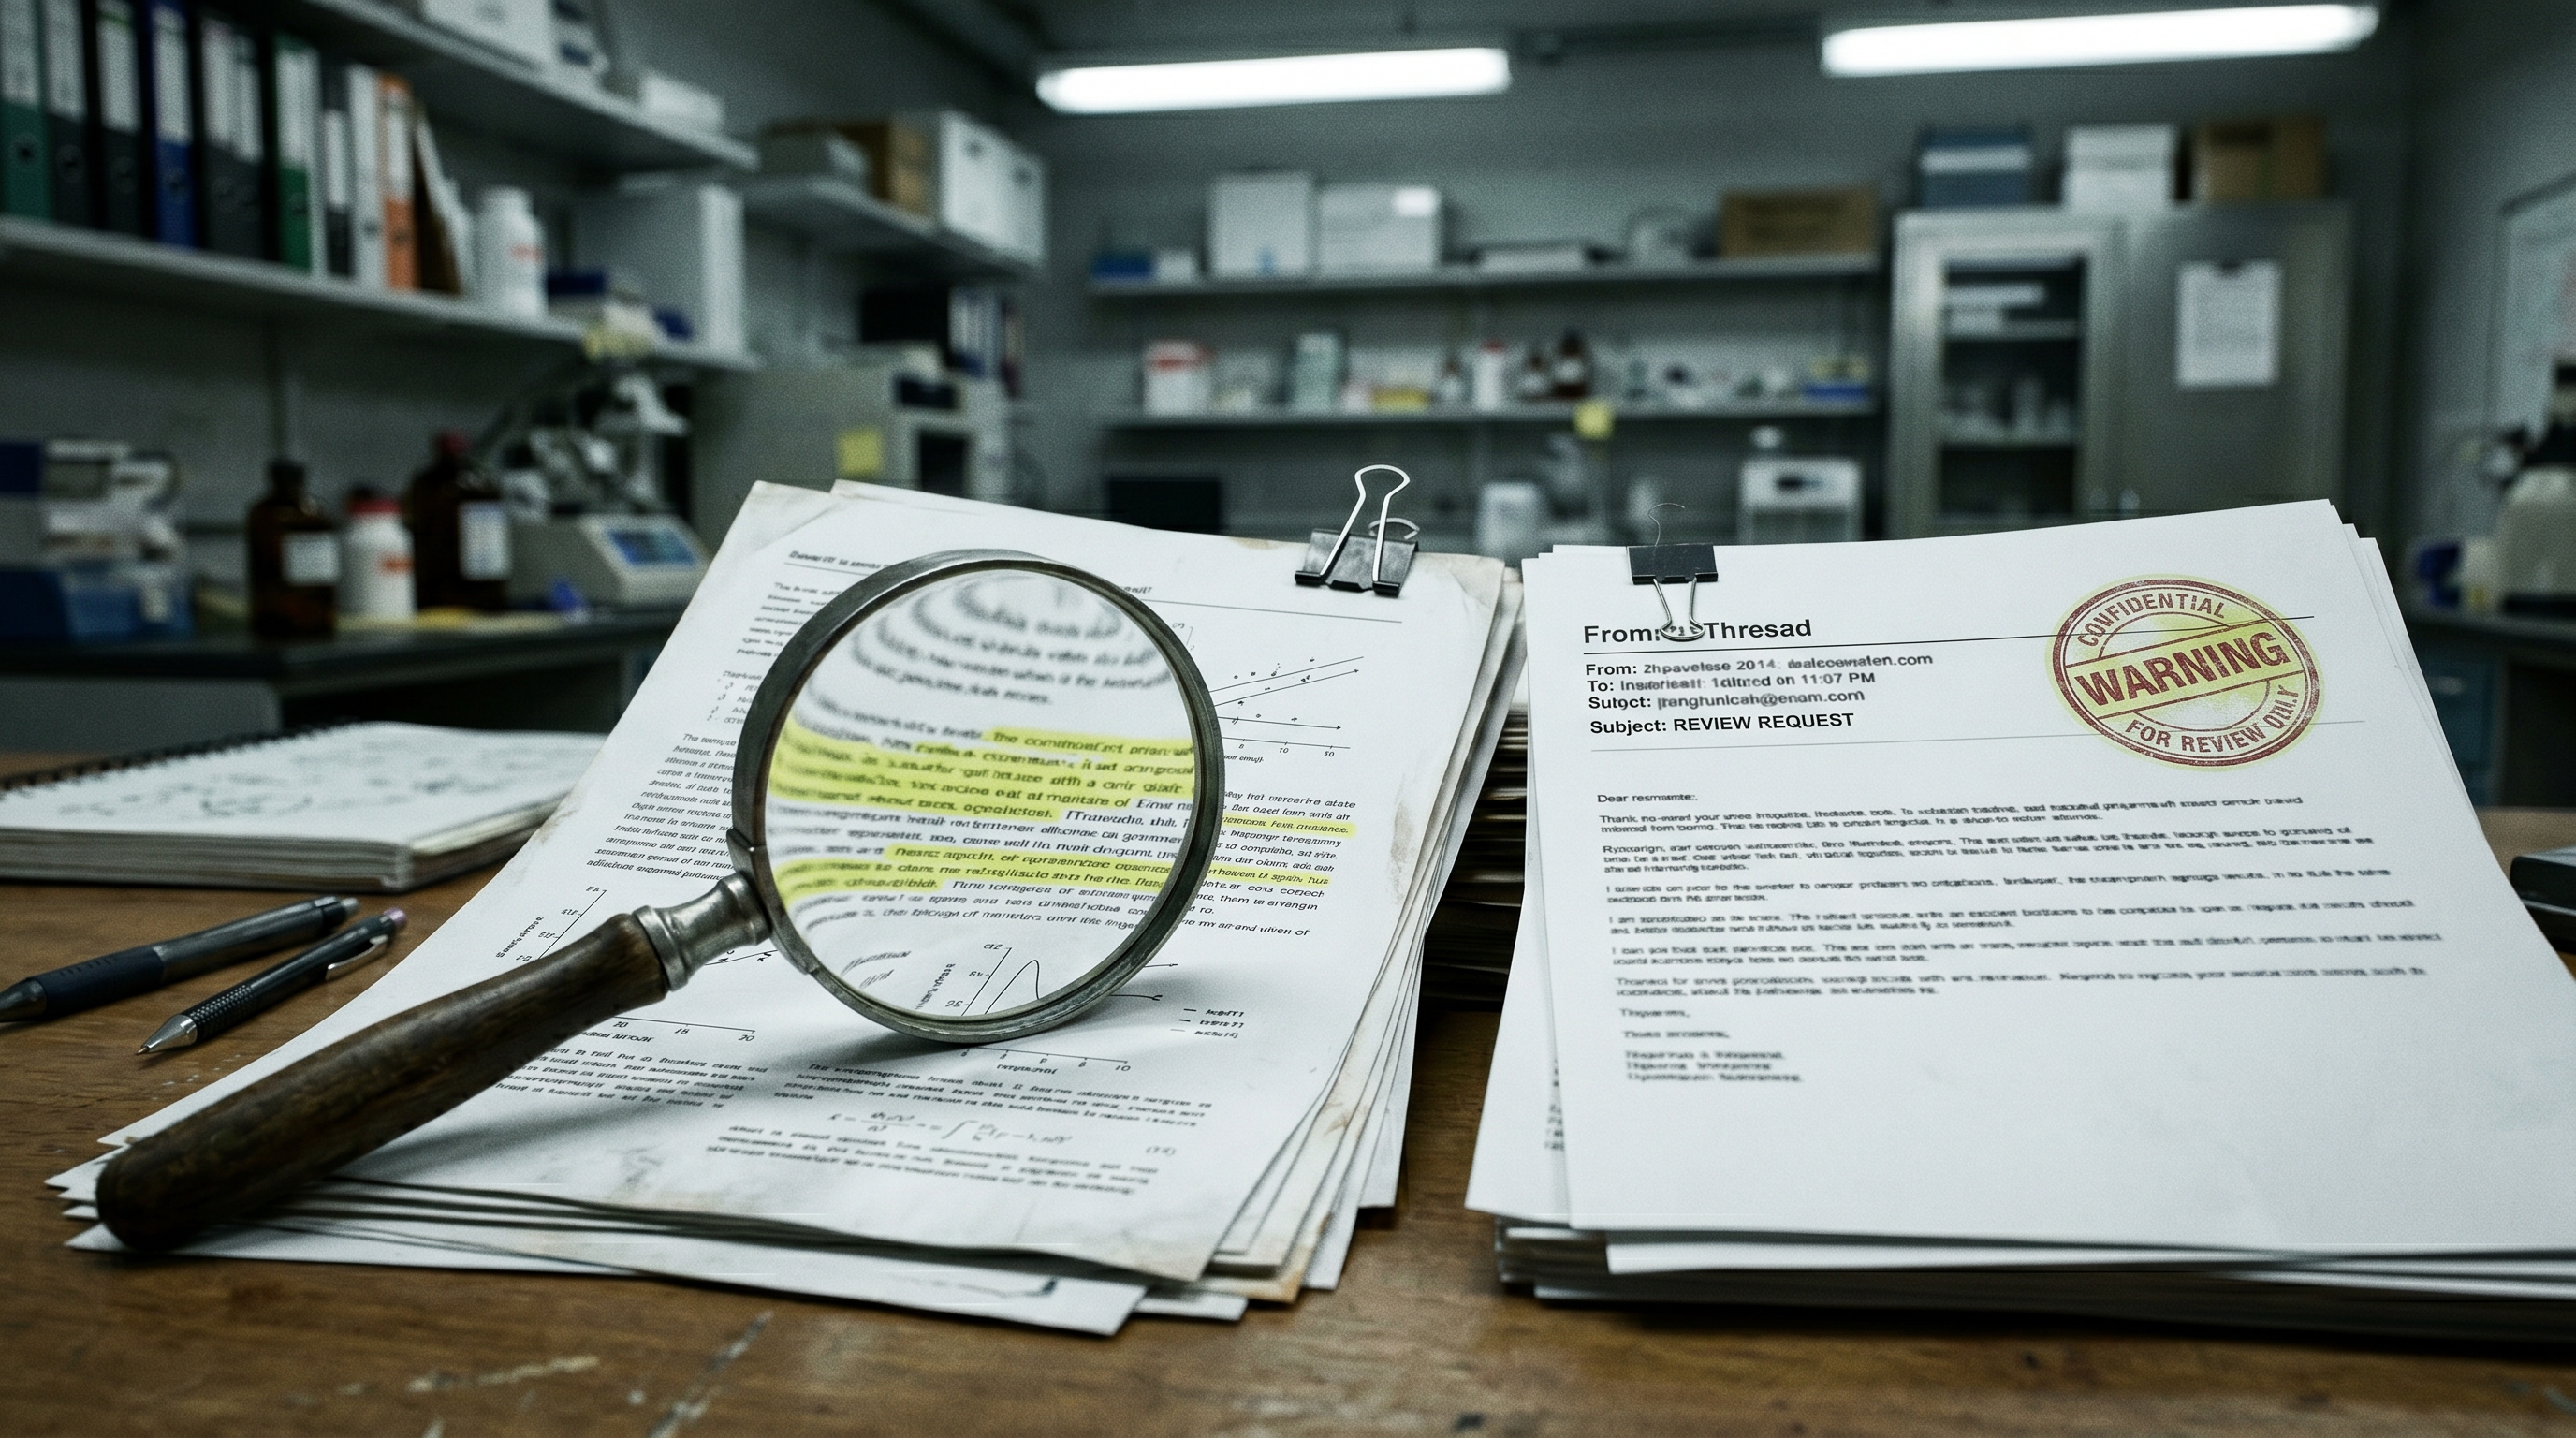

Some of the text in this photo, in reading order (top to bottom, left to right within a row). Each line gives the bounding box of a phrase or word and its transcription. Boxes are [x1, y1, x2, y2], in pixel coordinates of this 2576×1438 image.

[1704, 619, 1812, 640] Thresad
[2077, 593, 2226, 648] CONFIDENTIAL
[1586, 663, 1637, 676] From:
[2074, 631, 2291, 707] WARNING
[1587, 680, 1615, 692] To:
[1801, 673, 1842, 684] 11:07
[1849, 671, 1876, 683] PM
[1590, 712, 1855, 737] Subject: REVIEW REQUEST
[2125, 718, 2173, 749] FOR
[2181, 723, 2267, 754] REVIEW
[1597, 794, 1629, 803] Dear
